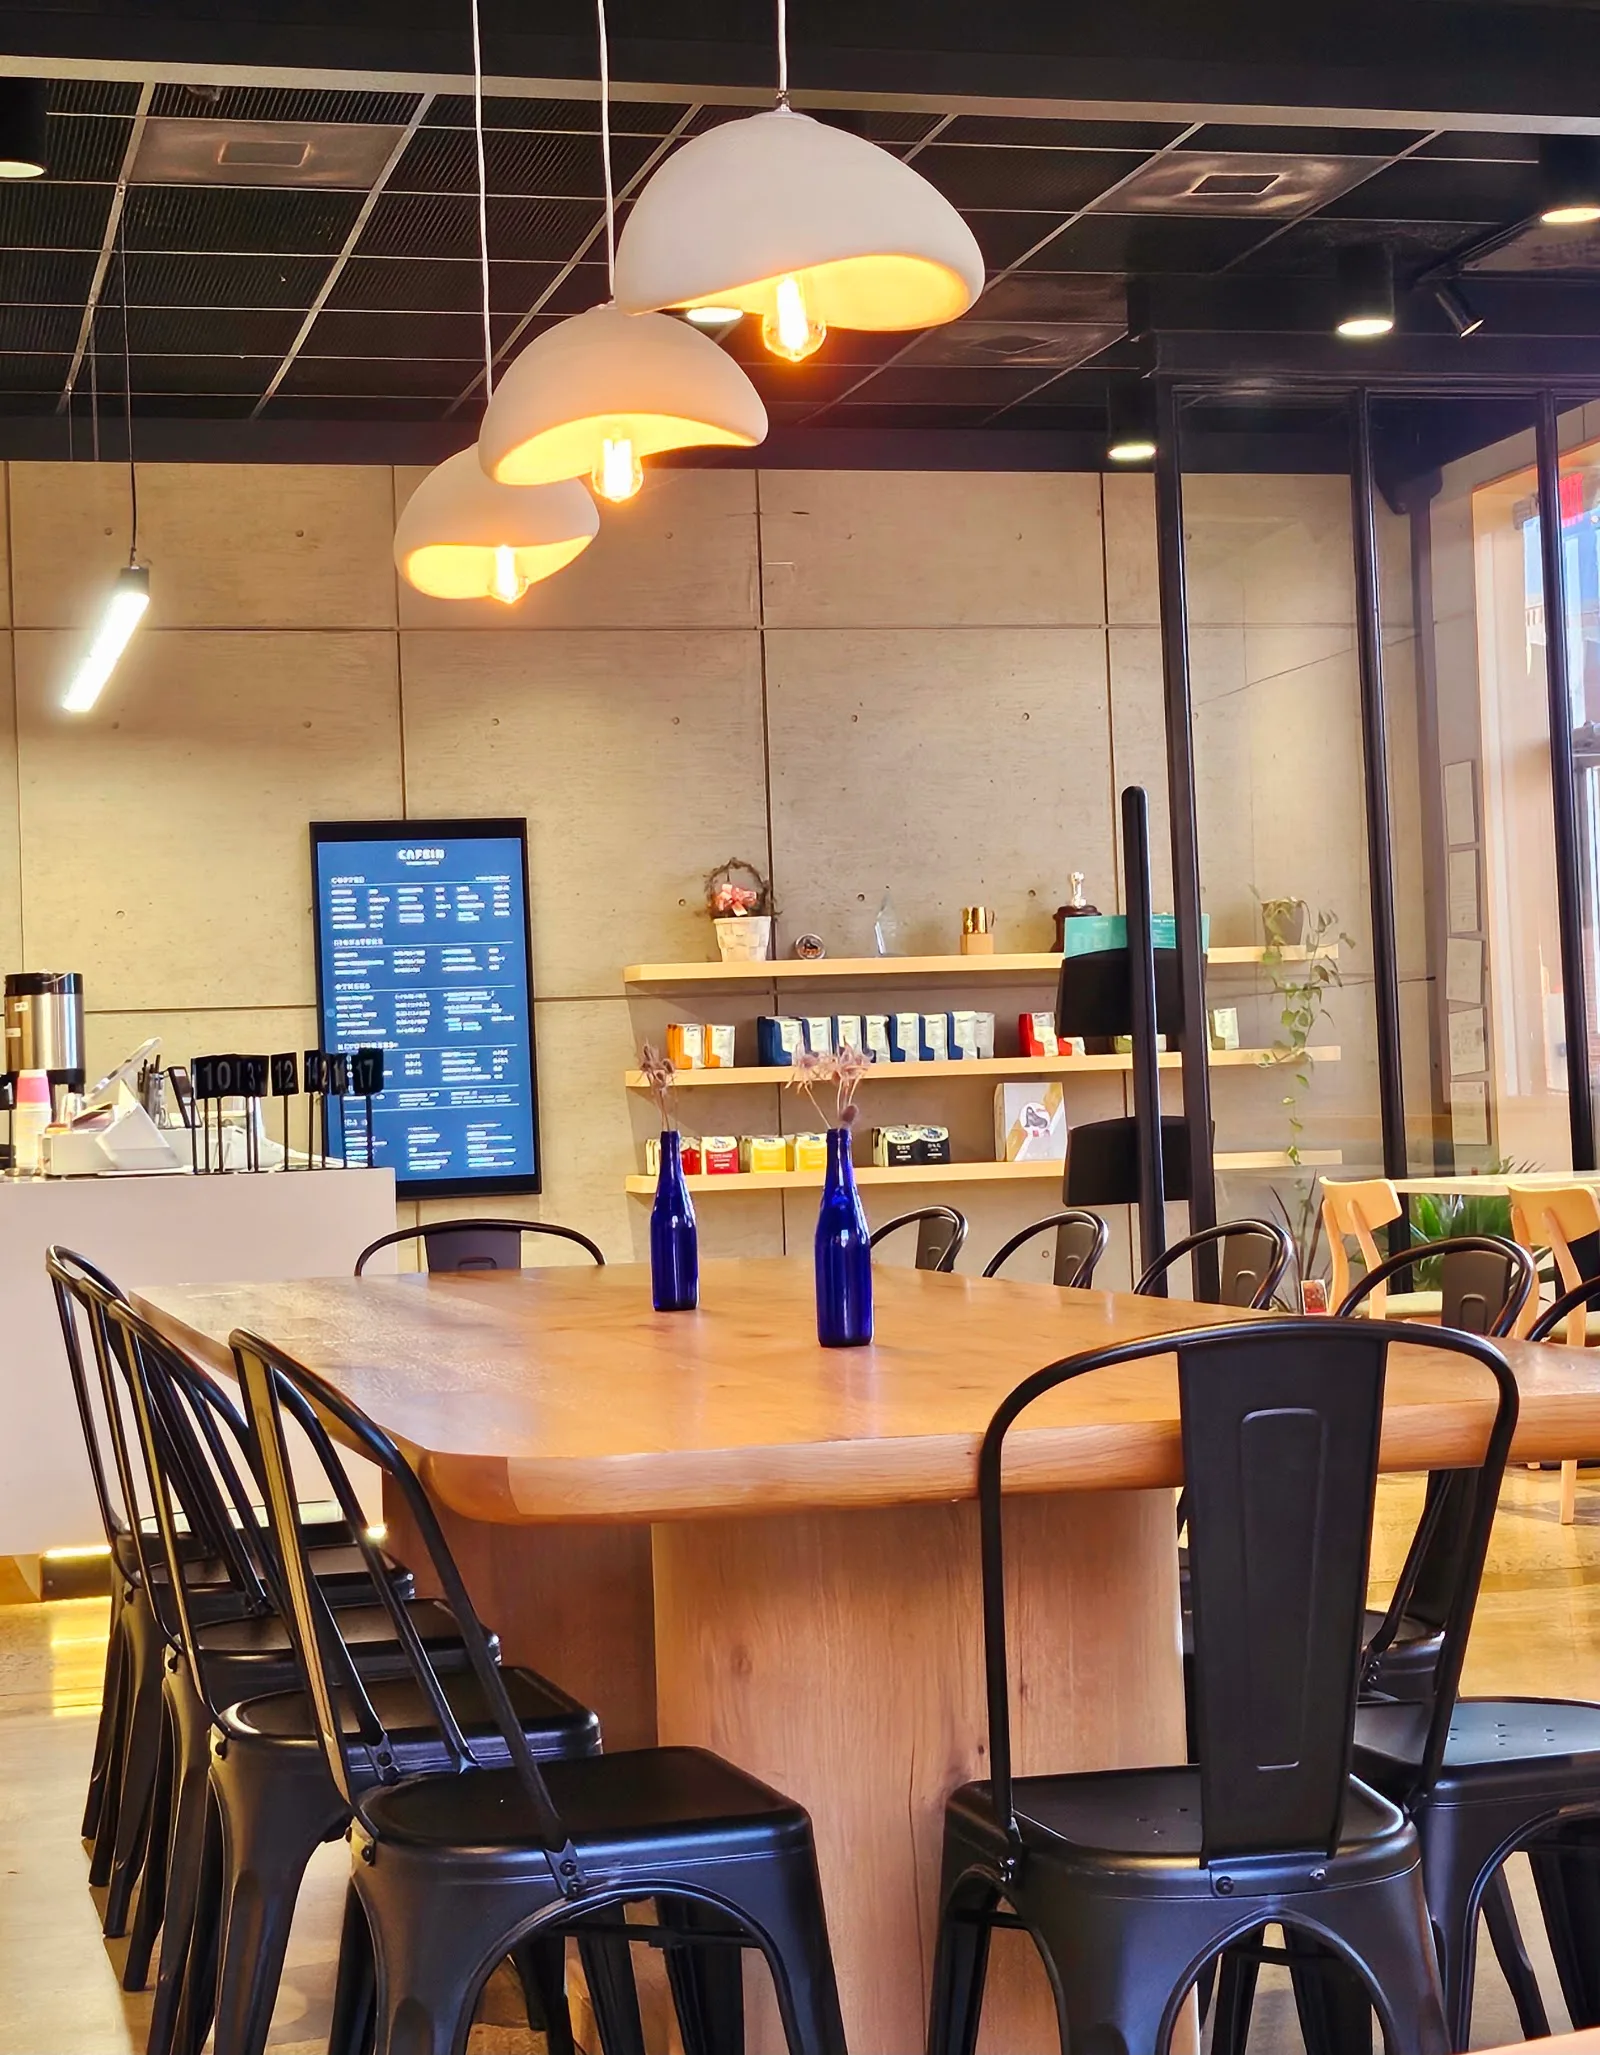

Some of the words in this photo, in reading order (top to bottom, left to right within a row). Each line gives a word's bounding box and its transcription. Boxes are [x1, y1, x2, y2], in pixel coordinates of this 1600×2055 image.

[203, 1061, 231, 1091] 10
[274, 1060, 295, 1089] 12
[356, 1059, 374, 1089] 17
